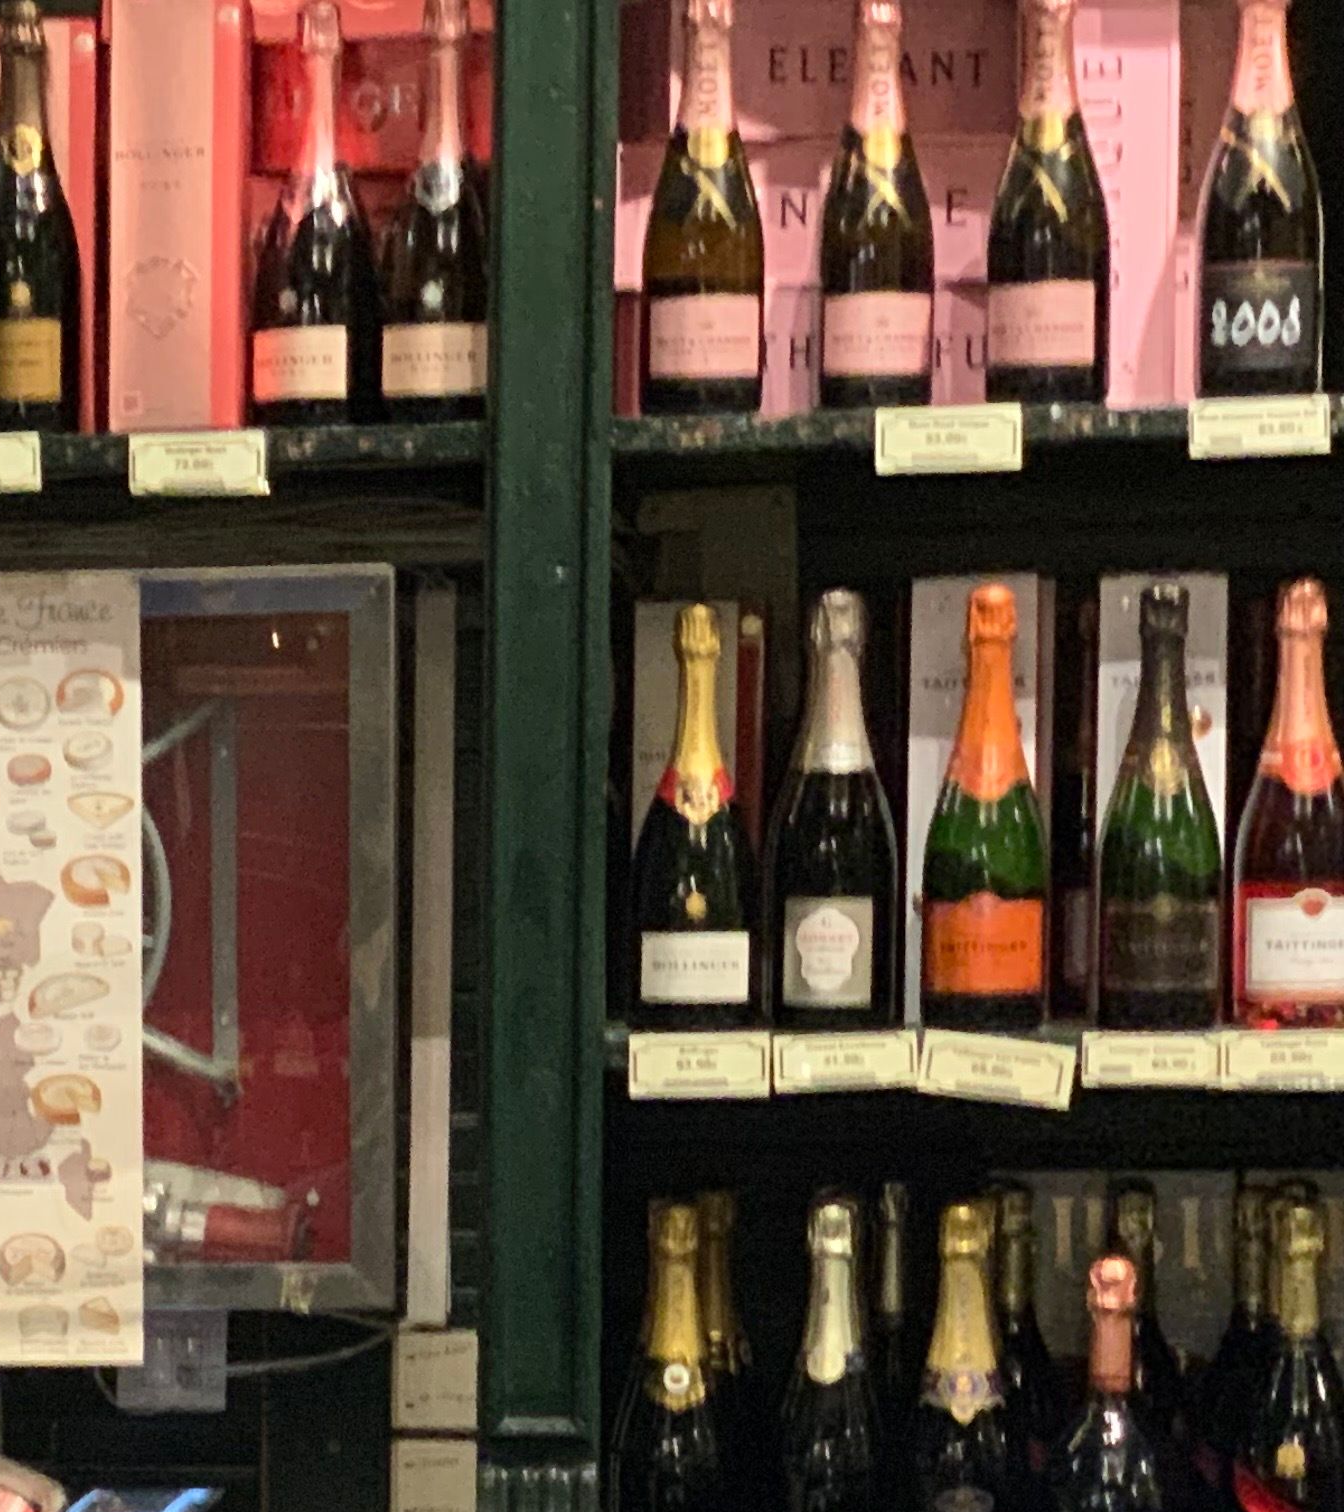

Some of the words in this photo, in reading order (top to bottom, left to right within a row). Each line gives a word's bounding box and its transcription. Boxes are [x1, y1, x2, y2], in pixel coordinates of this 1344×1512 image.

[768, 46, 988, 88] ELEANT
[15, 592, 113, 632] France
[651, 958, 741, 973] BOLLINGER
